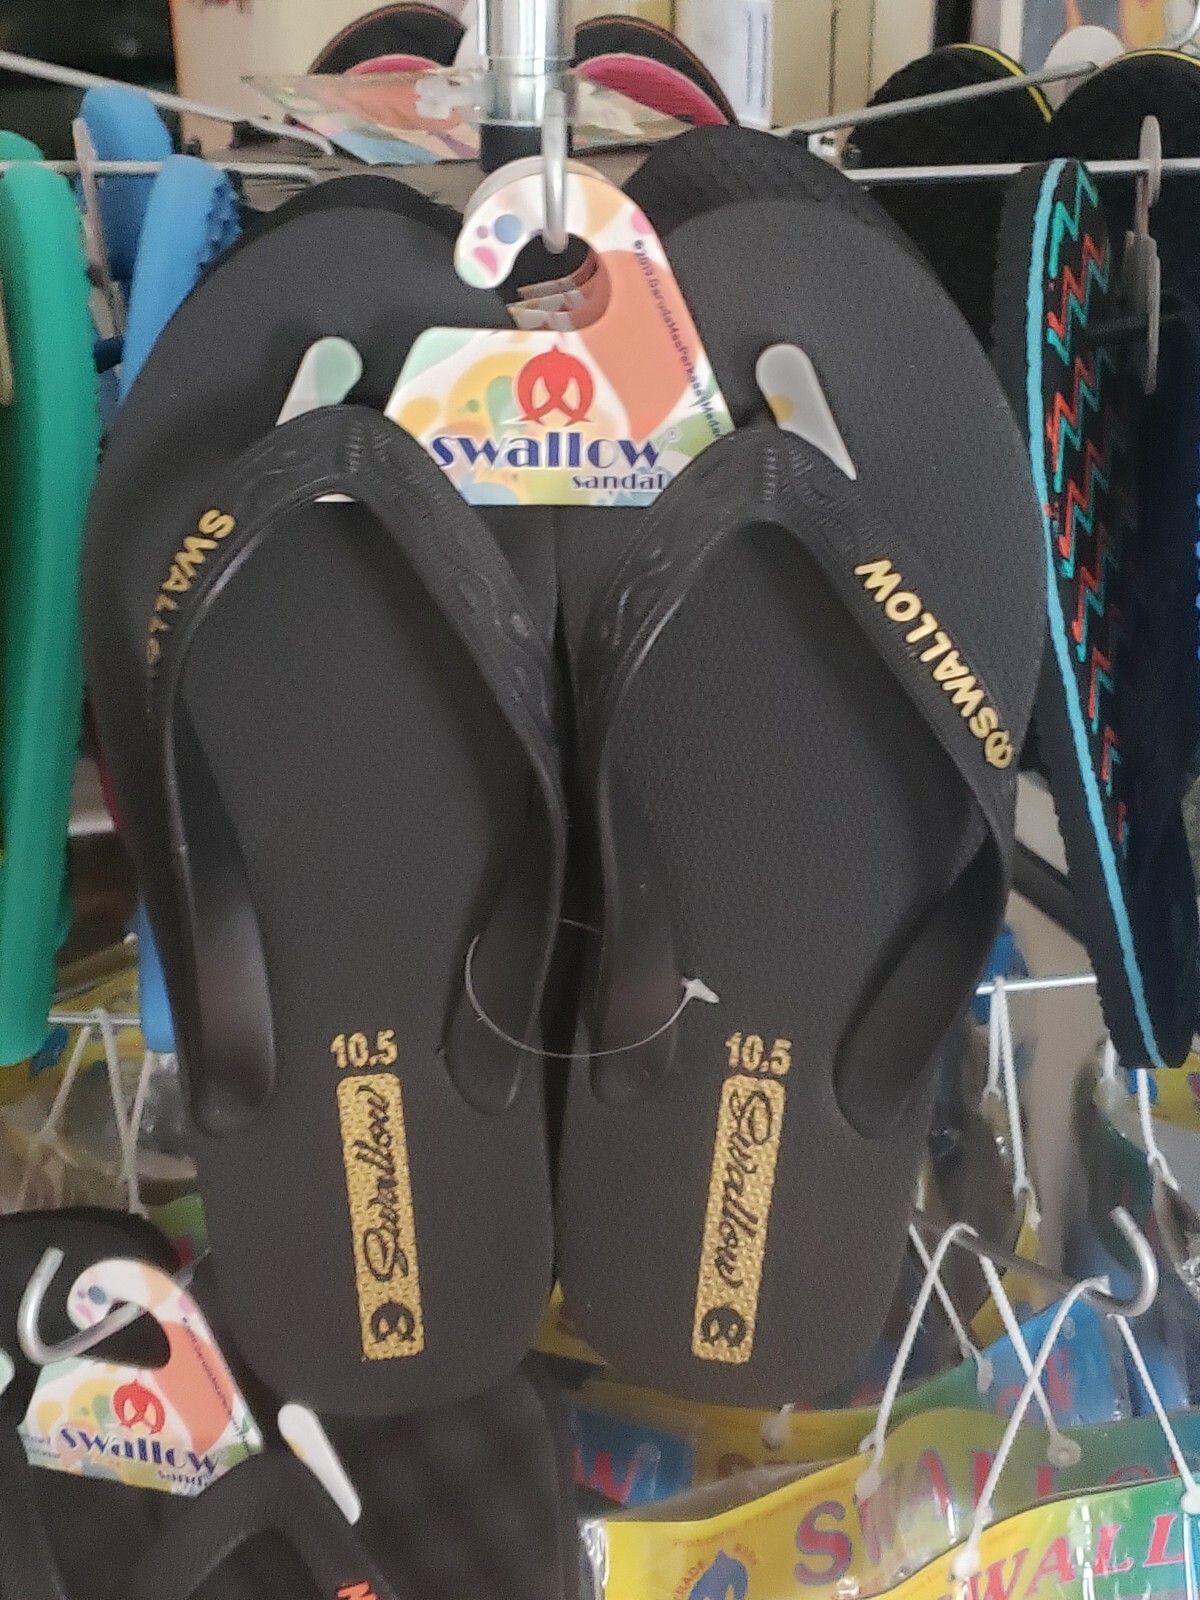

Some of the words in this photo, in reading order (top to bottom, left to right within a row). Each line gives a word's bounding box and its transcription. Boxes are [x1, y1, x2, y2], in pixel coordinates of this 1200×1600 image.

[432, 432, 664, 468] swallow
[572, 473, 666, 490] sandal
[853, 559, 999, 739] SWALLOW
[330, 1029, 399, 1068] 10.5
[724, 1032, 793, 1076] 10.5
[715, 1089, 773, 1288] Swallow
